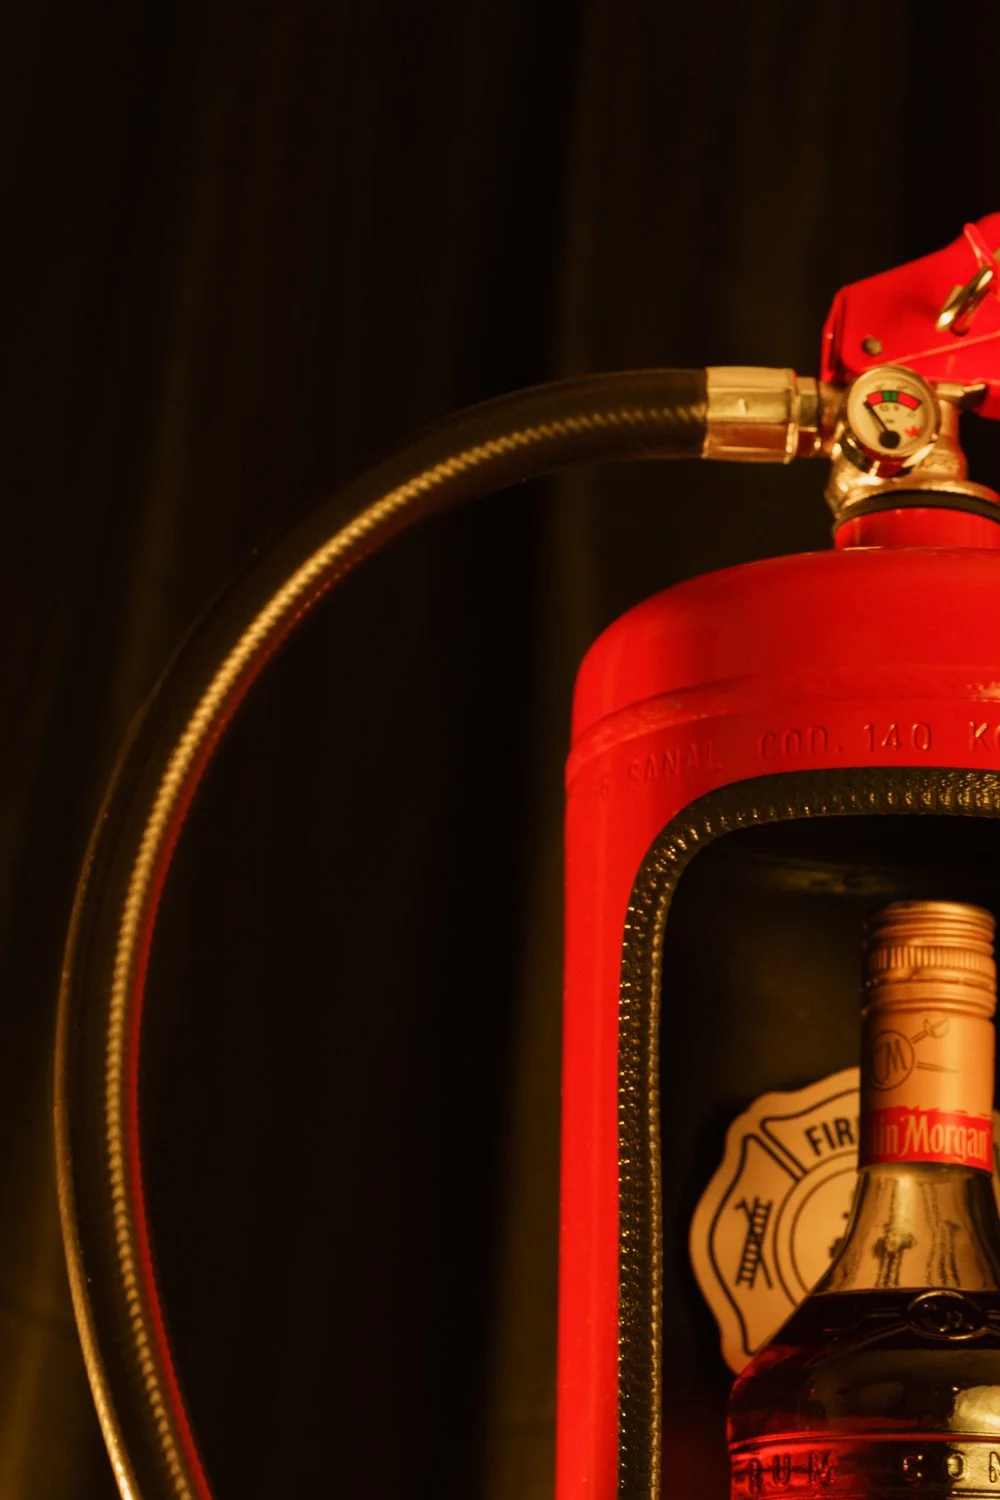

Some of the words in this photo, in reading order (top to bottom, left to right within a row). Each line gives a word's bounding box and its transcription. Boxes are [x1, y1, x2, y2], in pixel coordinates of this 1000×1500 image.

[862, 721, 933, 754] 140
[804, 1116, 860, 1157] FIR
[899, 1113, 988, 1164] Morgan
